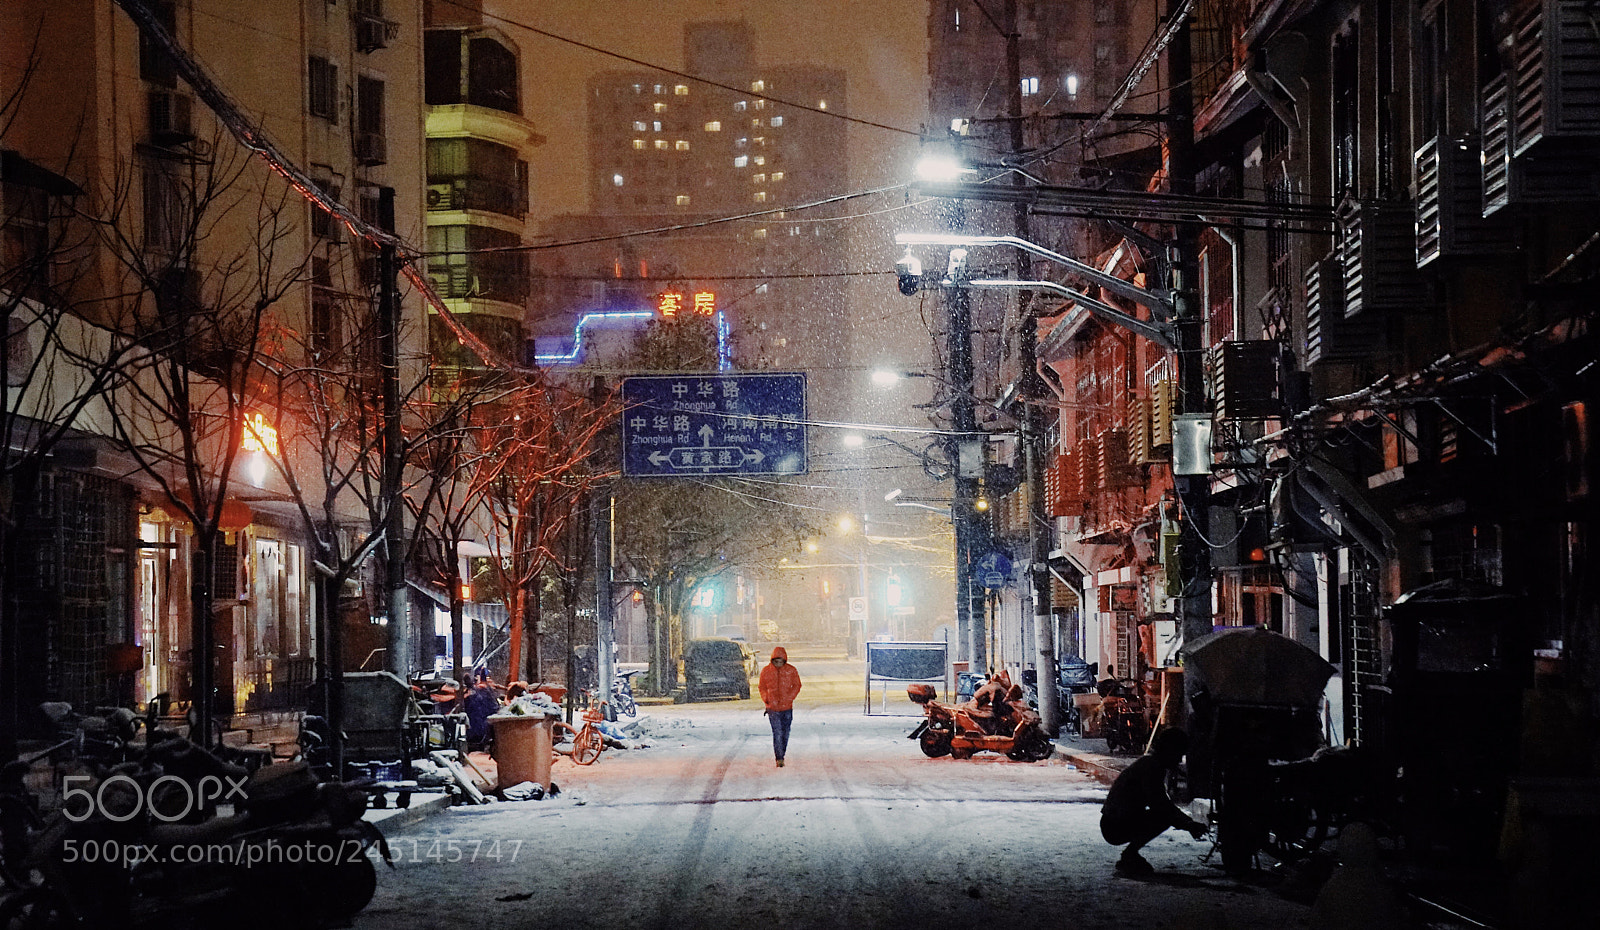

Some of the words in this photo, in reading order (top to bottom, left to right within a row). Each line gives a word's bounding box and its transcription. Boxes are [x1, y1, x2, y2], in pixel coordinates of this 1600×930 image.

[658, 291, 715, 316] 客房
[671, 380, 740, 398] 中华路
[673, 400, 716, 411] Zhonghua
[725, 400, 738, 410] Rd
[630, 415, 690, 432] 中华路
[631, 434, 673, 446] Zhonghua
[677, 434, 690, 444] Rd
[760, 432, 772, 442] Rd
